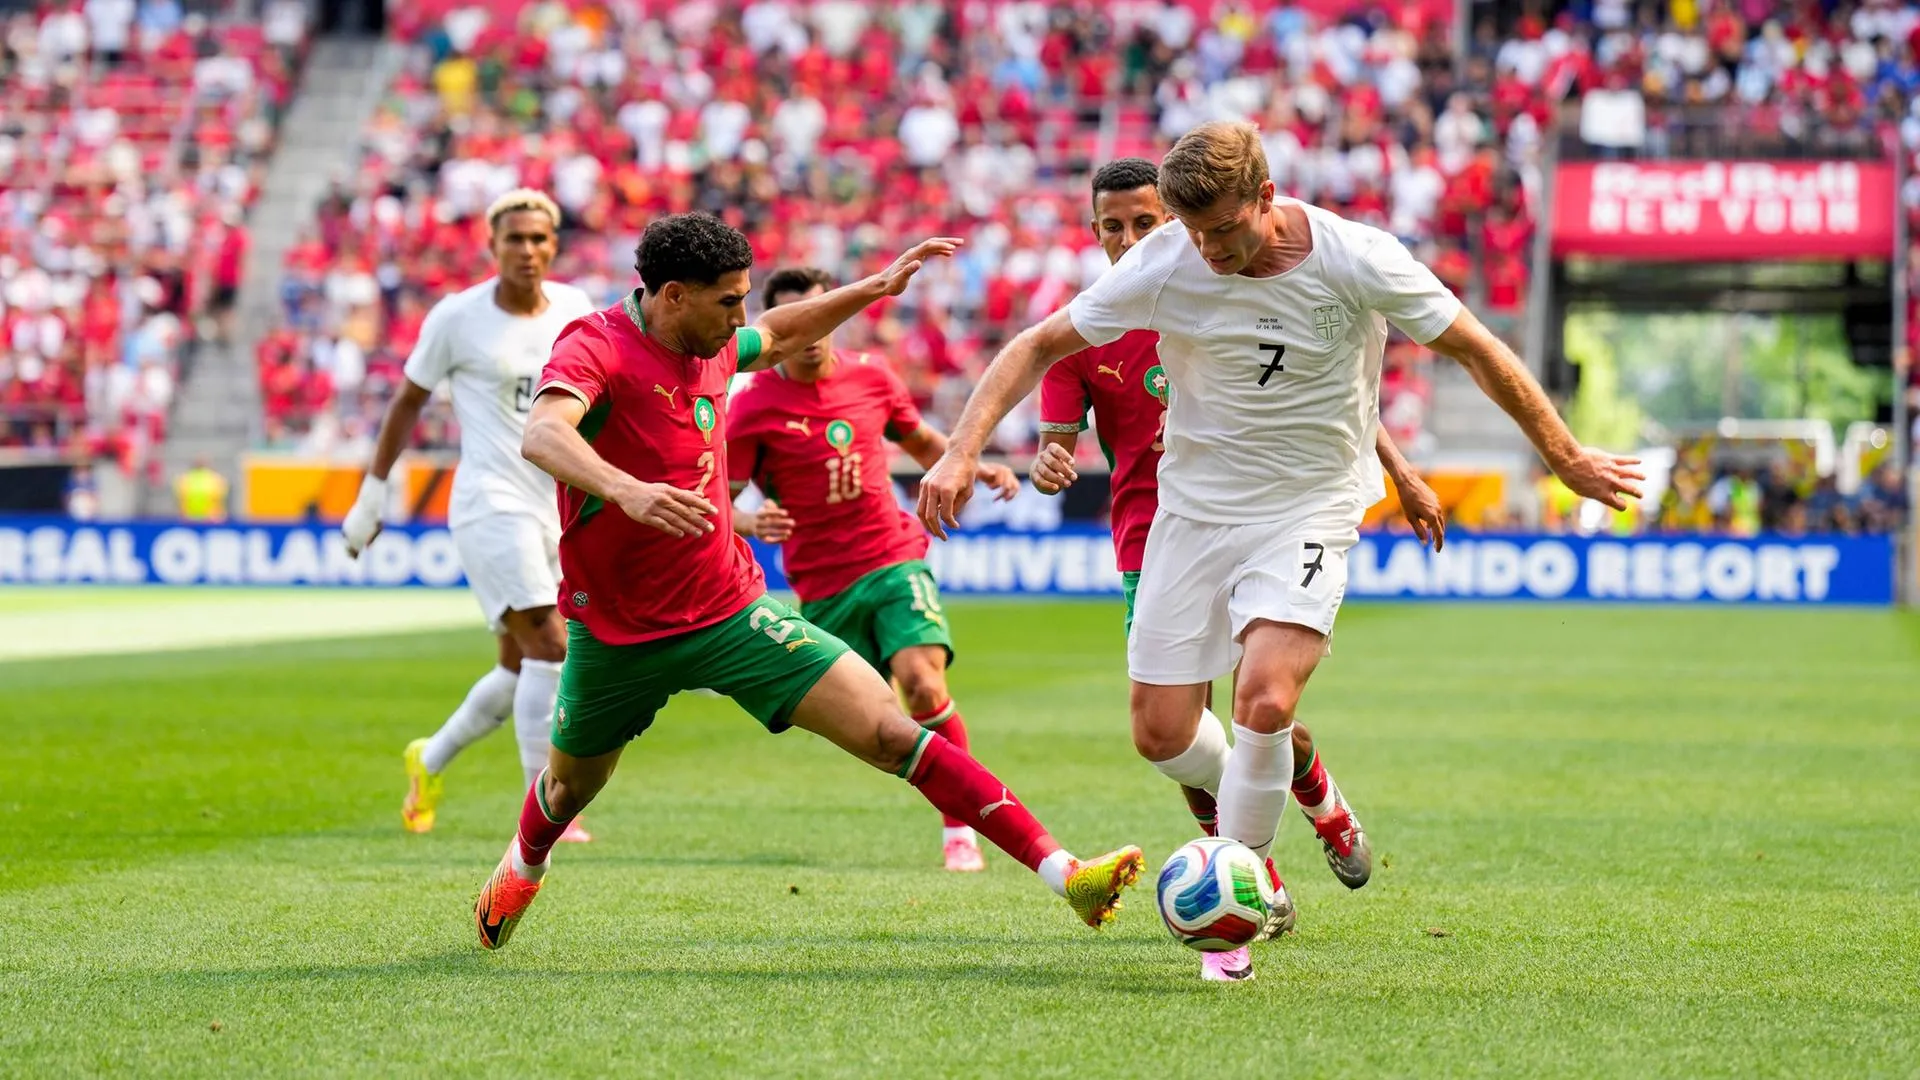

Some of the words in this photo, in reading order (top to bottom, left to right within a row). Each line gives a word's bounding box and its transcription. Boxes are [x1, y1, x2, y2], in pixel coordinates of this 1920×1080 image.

[1590, 198, 1699, 234] NEW
[1718, 198, 1860, 234] YORK
[1258, 343, 1285, 387] 7
[825, 452, 862, 504] 10
[151, 527, 465, 585] ORLANDO
[1300, 542, 1324, 588] 7
[1347, 538, 1579, 598] LANDO
[1586, 541, 1840, 600] RESORT
[749, 606, 796, 645] 2
